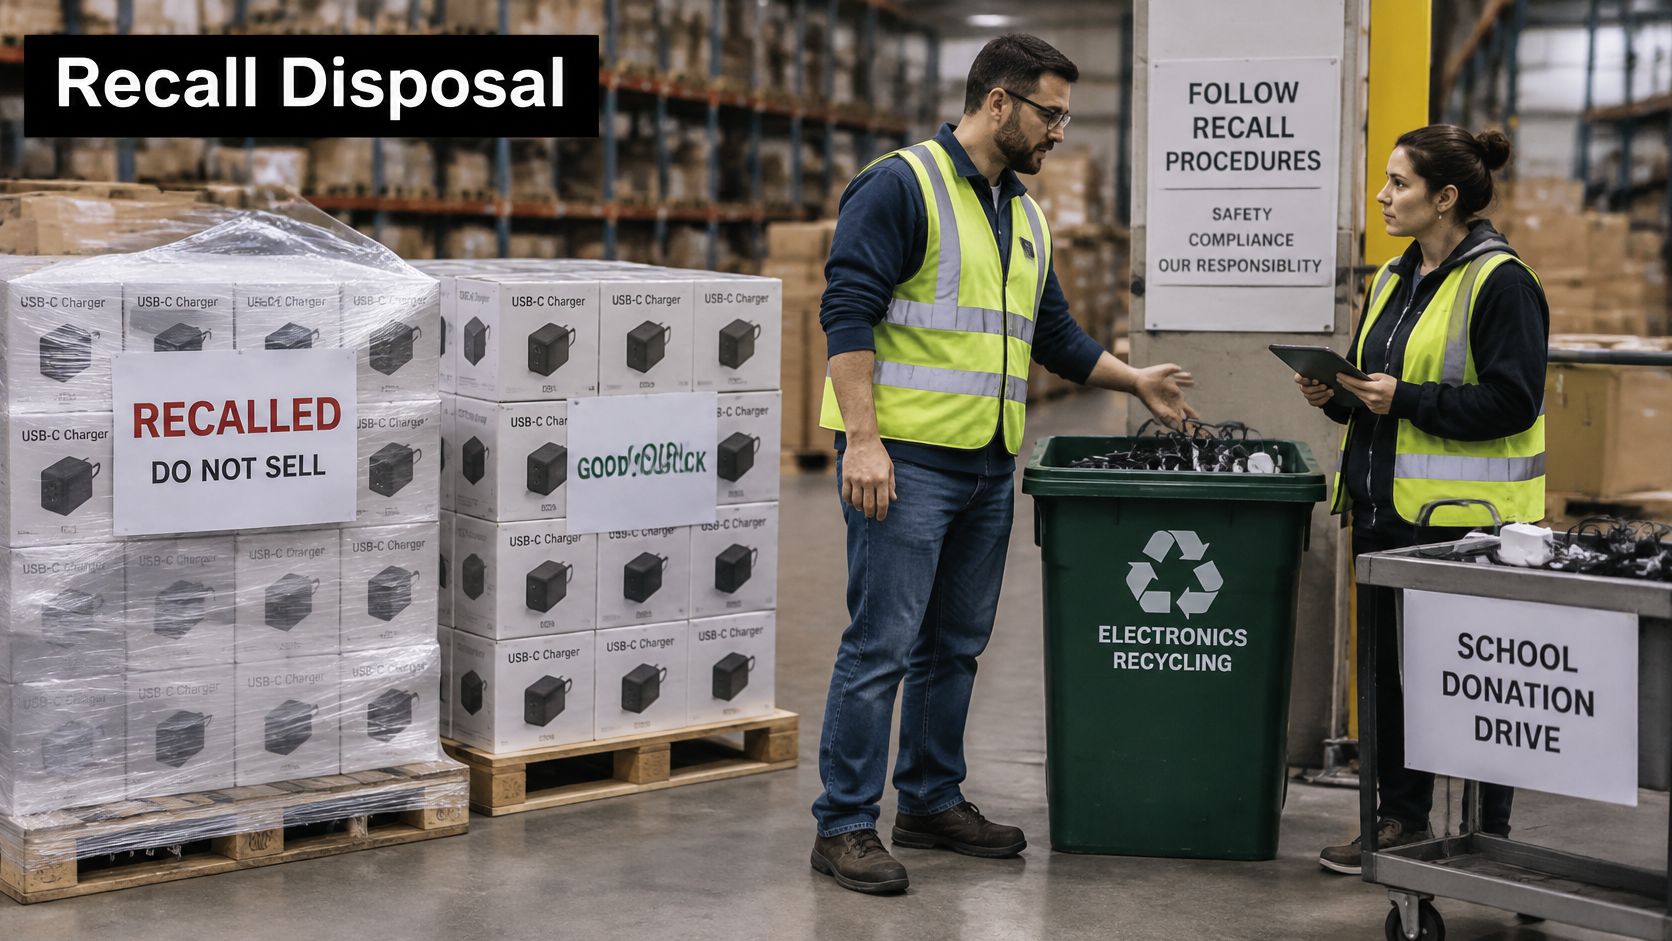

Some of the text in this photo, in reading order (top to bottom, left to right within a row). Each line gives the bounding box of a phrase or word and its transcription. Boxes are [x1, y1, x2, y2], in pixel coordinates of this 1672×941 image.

[1189, 81, 1299, 104] FOLLOW
[1193, 116, 1294, 139] RECALL
[1166, 150, 1321, 171] PROCEDURES
[1212, 207, 1272, 221] SAFETY
[1188, 233, 1294, 247] COMPLIANCE
[1158, 258, 1322, 273] OUR RESPONSIBLITY
[20, 296, 106, 310] USB-C Charger
[138, 296, 219, 310] USB-C Charger
[512, 296, 586, 308] USB-C Charger
[612, 294, 681, 307] USB-C Charger
[704, 293, 769, 305] USB-C Charger
[133, 396, 341, 438] RECALLED
[717, 406, 769, 418] B-C Charger
[511, 416, 567, 428] USB-C Char
[22, 429, 109, 442] USB-C Charger
[152, 453, 326, 484] DO NOT SELL
[732, 518, 767, 529] Charger
[352, 541, 385, 552] USB-C
[509, 533, 582, 547] USB-C Charger
[249, 548, 283, 560] USB-C
[22, 562, 60, 574] USB-C
[138, 556, 173, 567] USB-C
[698, 627, 764, 641] USB-C Charger
[1098, 625, 1248, 647] ELECTRONICS
[606, 638, 675, 652] USB-C Charger
[508, 648, 580, 664] USB-C Charger
[1457, 632, 1578, 673] SCHOOL
[1113, 651, 1232, 672] RECYCLING
[352, 664, 385, 677] USBC
[247, 675, 282, 688] USB-C
[1442, 670, 1594, 717] DONATION
[1475, 715, 1561, 753] DRIVE
